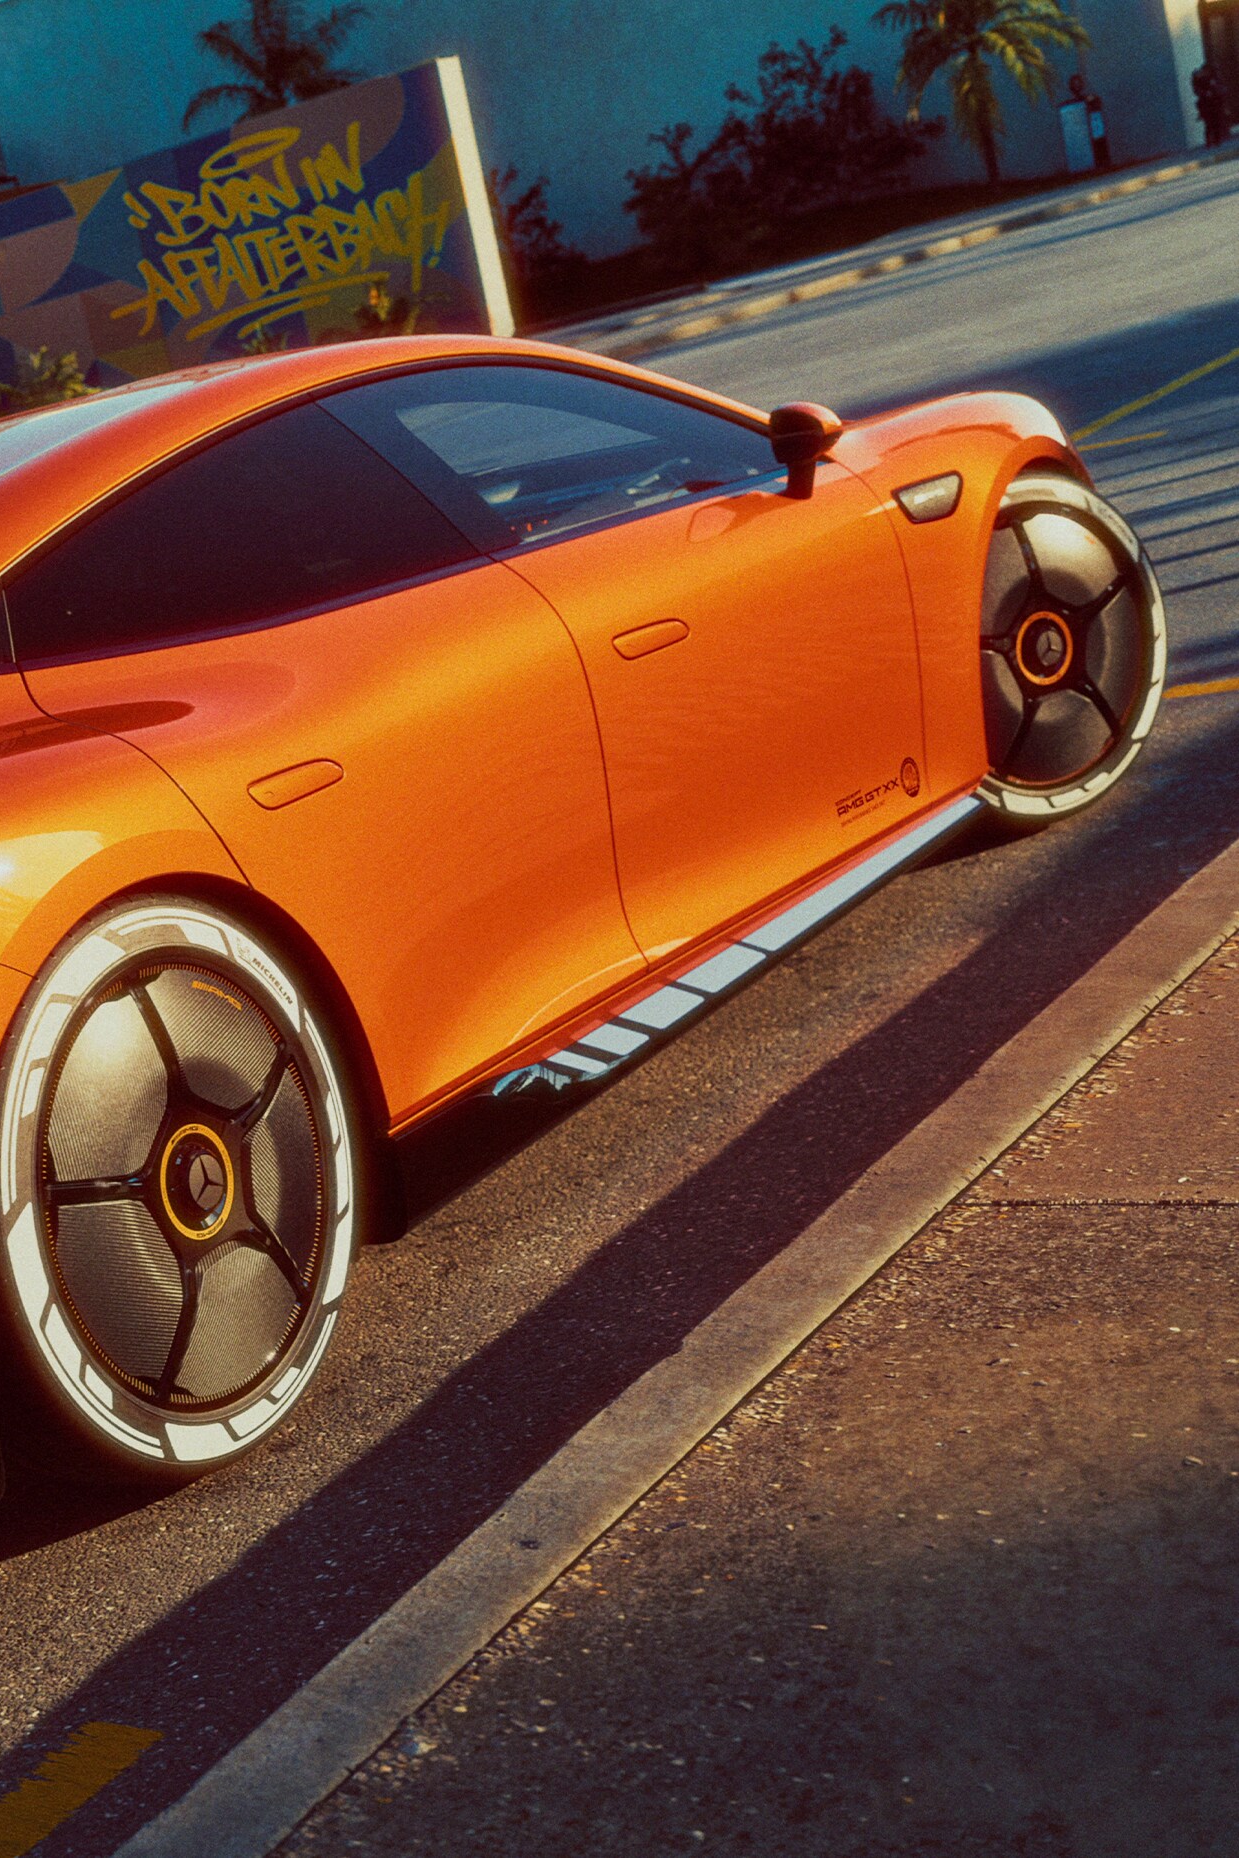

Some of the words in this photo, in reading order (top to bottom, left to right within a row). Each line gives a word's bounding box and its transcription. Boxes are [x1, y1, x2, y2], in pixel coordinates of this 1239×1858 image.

[299, 121, 364, 203] IN
[836, 796, 865, 817] AMG
[251, 957, 294, 1006] MICHELIN
